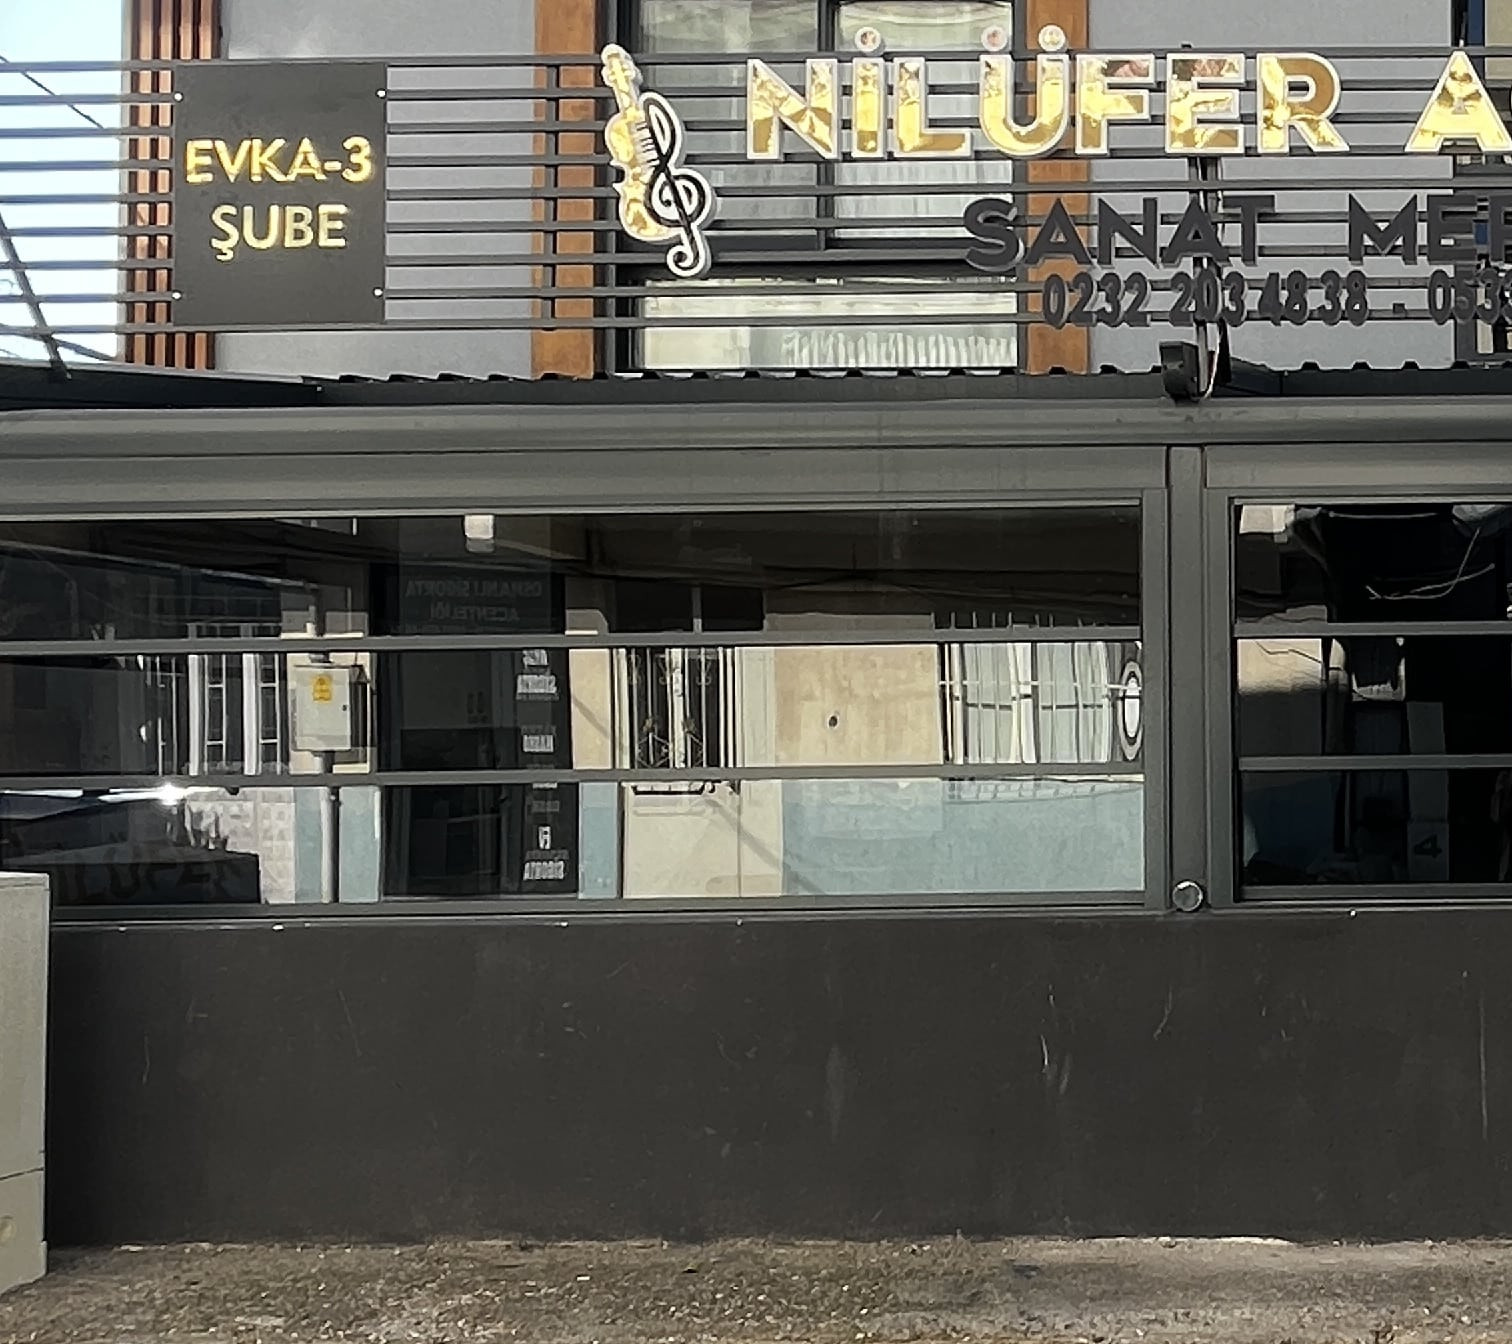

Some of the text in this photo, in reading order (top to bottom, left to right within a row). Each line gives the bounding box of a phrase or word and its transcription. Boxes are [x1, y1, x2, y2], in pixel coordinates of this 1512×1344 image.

[746, 23, 1350, 160] NİLÜFER
[185, 135, 374, 184] EVKA-3
[210, 203, 350, 262] ŞUBE
[963, 196, 1276, 273] SANAT
[1042, 270, 1152, 330] 0232
[1169, 268, 1247, 328] 203
[1257, 268, 1310, 327] 48
[1315, 268, 1369, 327] 38
